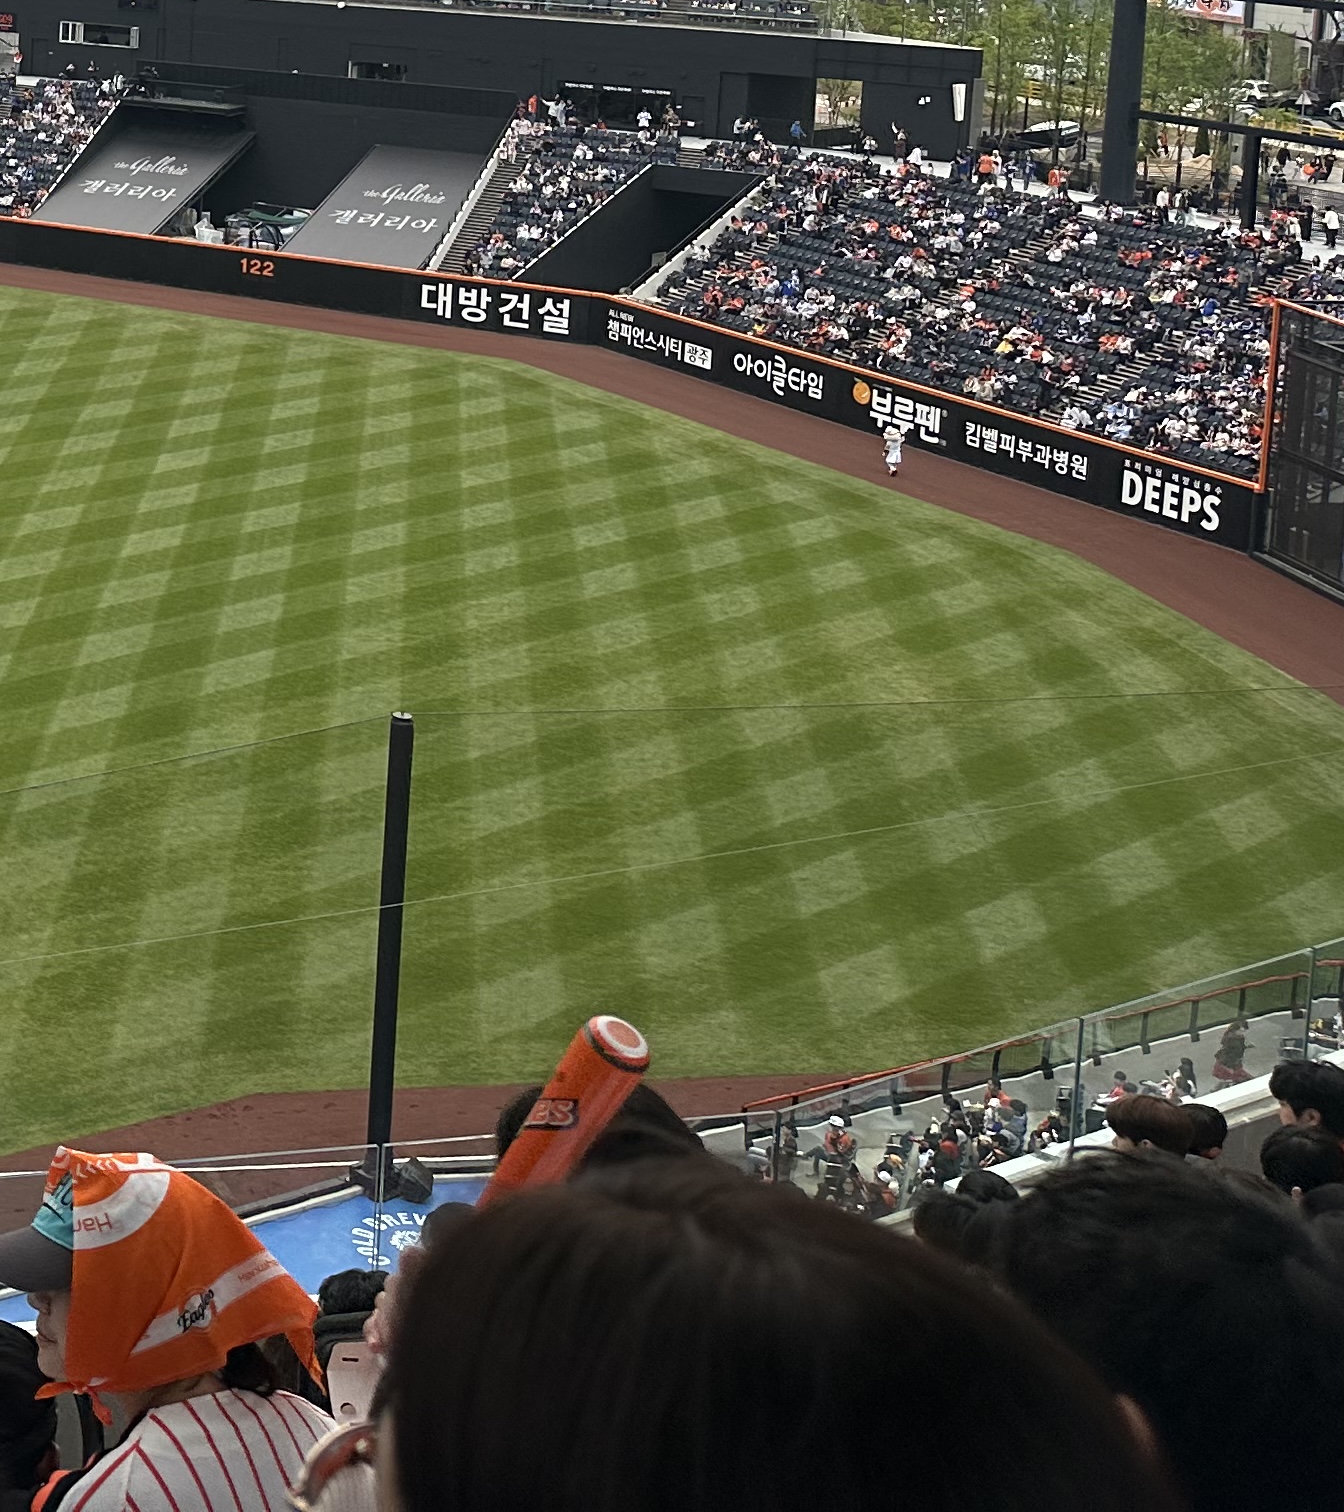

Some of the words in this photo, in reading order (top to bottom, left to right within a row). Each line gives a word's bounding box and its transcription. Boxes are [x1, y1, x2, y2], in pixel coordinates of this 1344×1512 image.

[78, 178, 177, 202] 갤러리아
[327, 208, 439, 233] 갤러리아
[240, 258, 275, 277] 122
[420, 282, 571, 335] 대방건설
[607, 319, 683, 362] 챔피언스시티
[687, 345, 710, 366] 광주
[733, 353, 824, 400] 아이클타임
[869, 389, 942, 444] 부루펜
[964, 420, 1089, 481] 킴벨피부과병원
[1121, 469, 1221, 532] DEEPS
